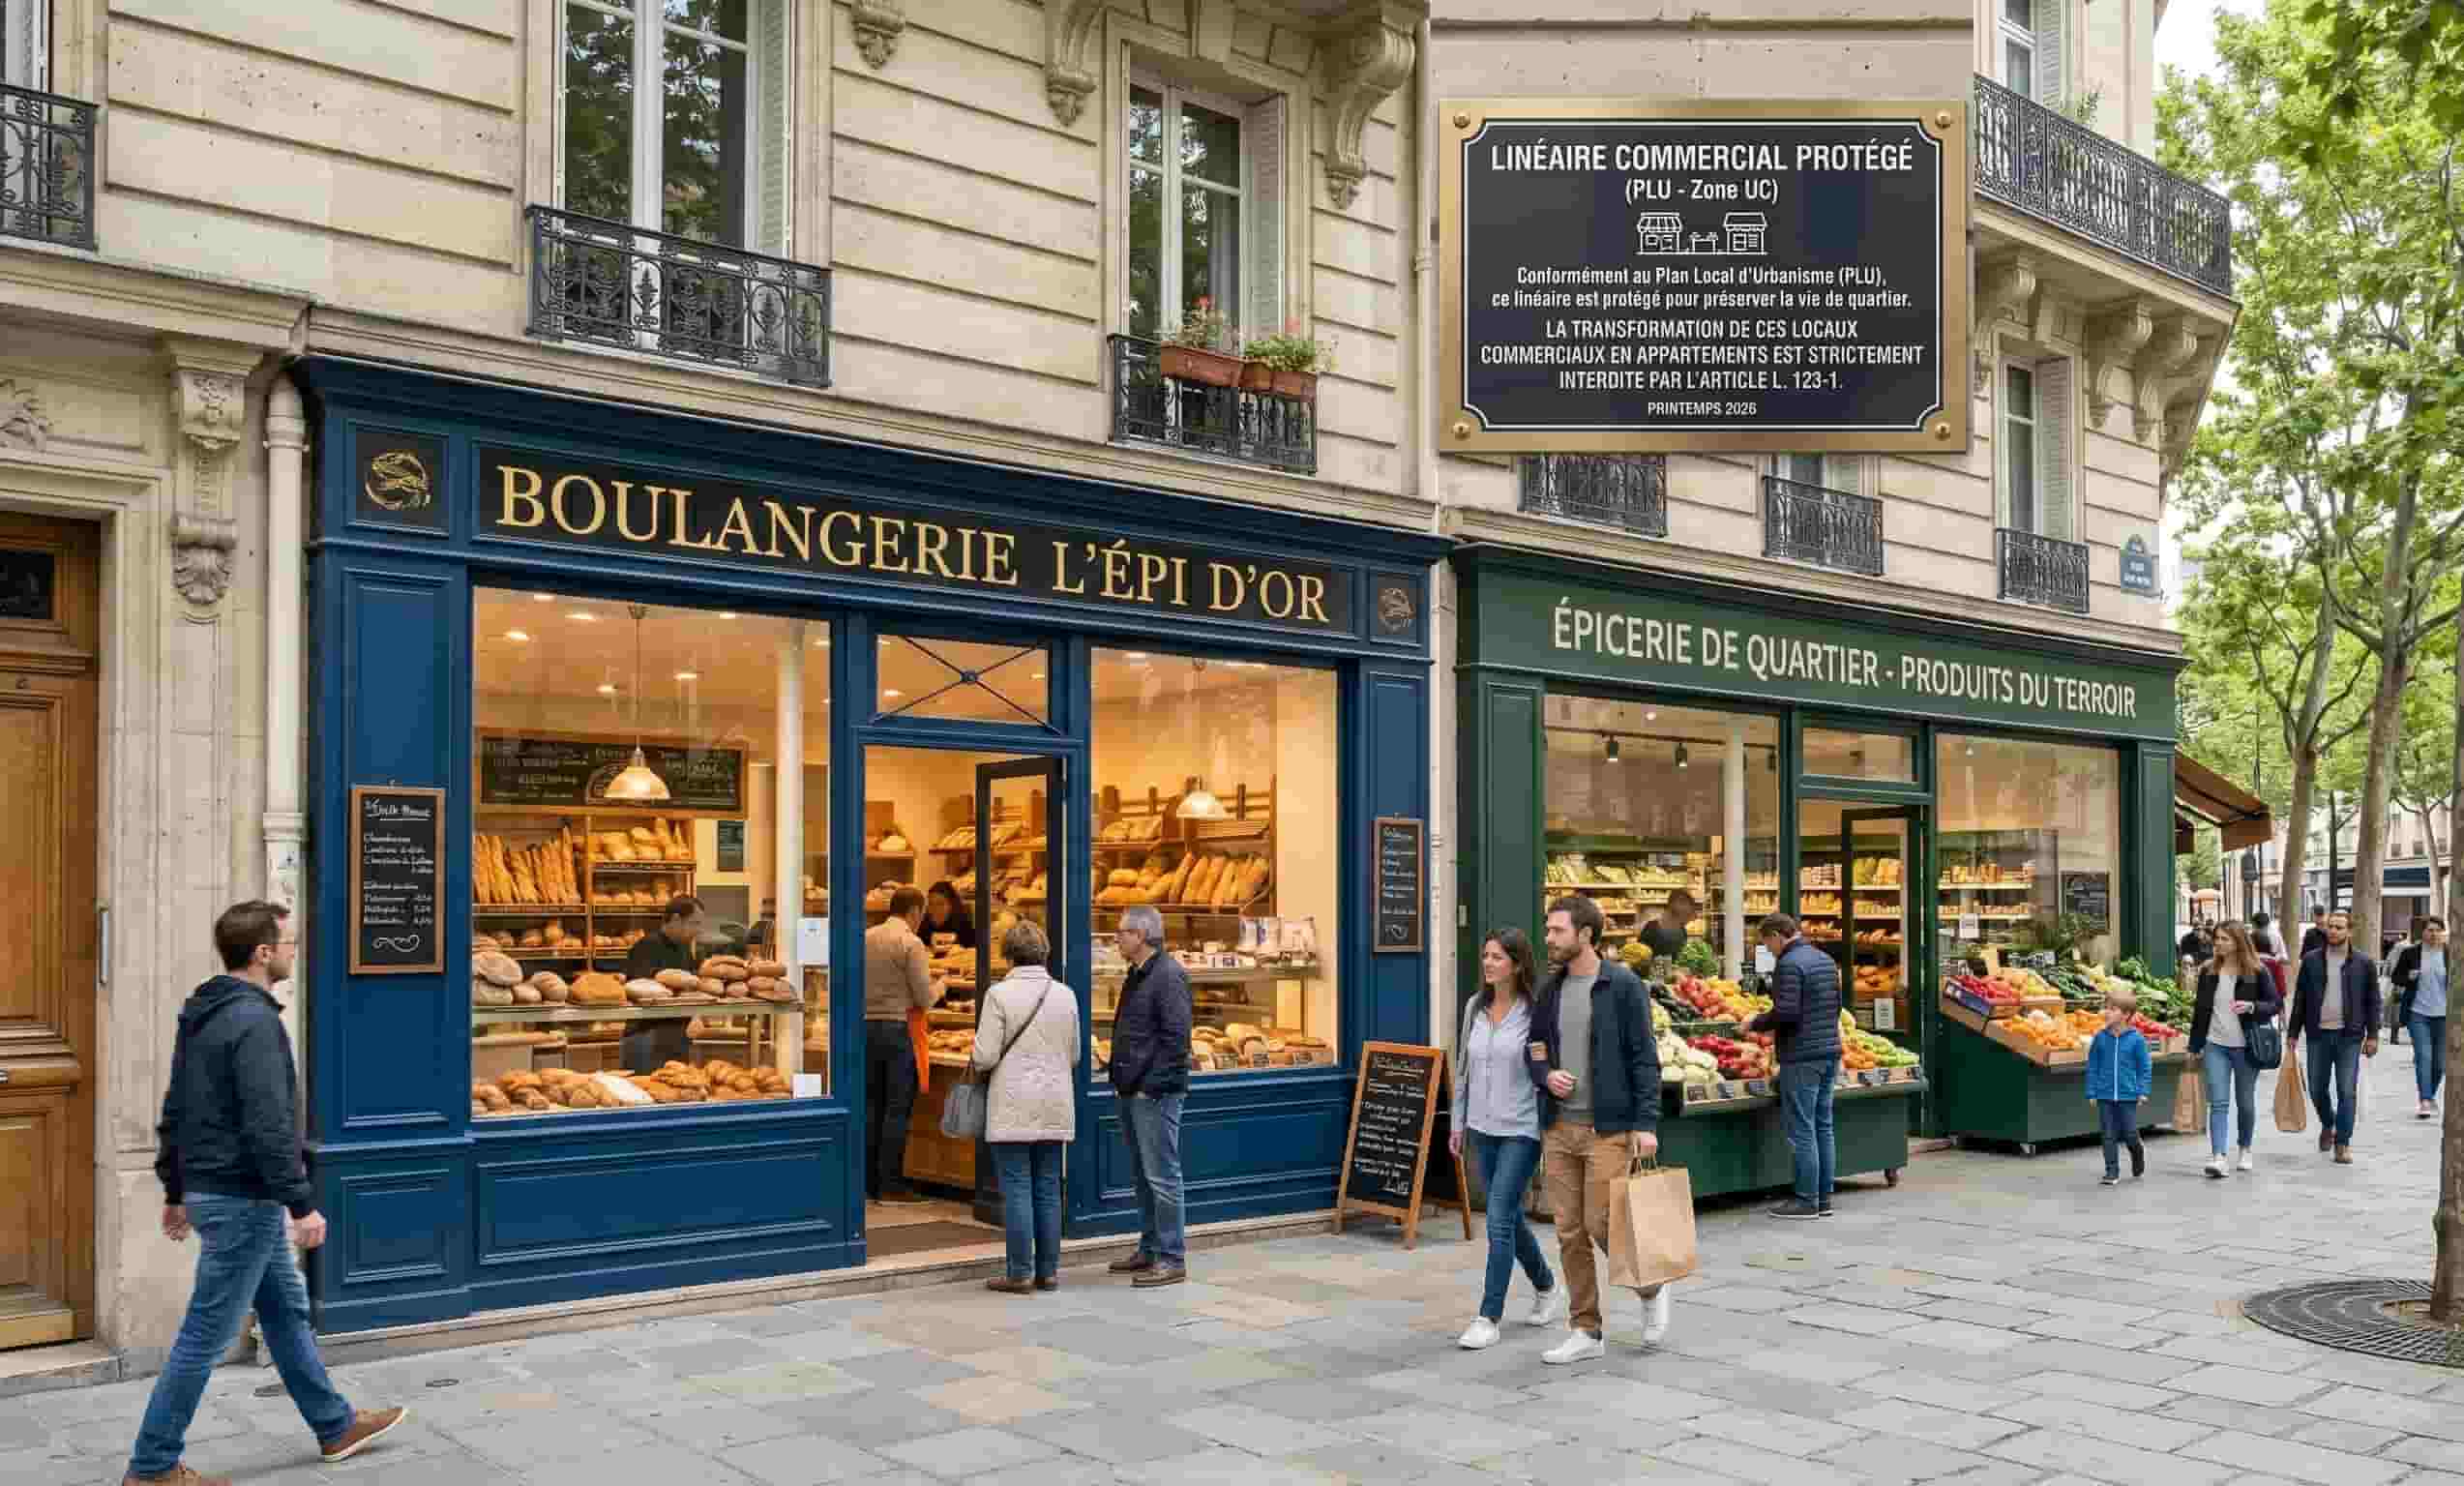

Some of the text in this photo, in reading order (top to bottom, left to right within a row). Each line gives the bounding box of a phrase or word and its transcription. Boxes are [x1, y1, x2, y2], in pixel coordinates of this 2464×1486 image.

[1492, 137, 1913, 170] LINÉAIRE COMMERCIAL PROTÉGÉ
[1625, 178, 1672, 205] (PLU
[1691, 178, 1738, 200] Zone
[1744, 178, 1778, 205] UC)
[1517, 266, 1628, 284] Conformément
[1633, 270, 1650, 284] au
[1656, 267, 1688, 284] Plan
[1694, 266, 1734, 284] Local
[1738, 266, 1834, 284] d'Urbanisme
[1492, 289, 1912, 311] ce linéaire est protégé pour préserver la vie de quartier.
[1546, 319, 1858, 339] LA TRANSFORMATION DE CES LOCAUX
[1481, 345, 1924, 365] COMMERCIAUX EN APPARTEMENTS EST STRICTEMENT
[1559, 371, 1645, 389] INTERDITE
[1649, 371, 1682, 389] PAR
[1686, 371, 1768, 389] L'ARTICLE
[1772, 371, 1788, 389] L.
[1648, 401, 1757, 415] PRINTEMPS 2026
[495, 464, 1019, 587] BOULANGERIE
[1555, 596, 1692, 665] ÉPICERIE
[1702, 627, 1739, 669] DE
[1747, 635, 1880, 688] QUARTIER
[1901, 655, 2013, 703] PRODUITS
[2019, 671, 2050, 707] DU
[2054, 676, 2137, 720] TERROIR
